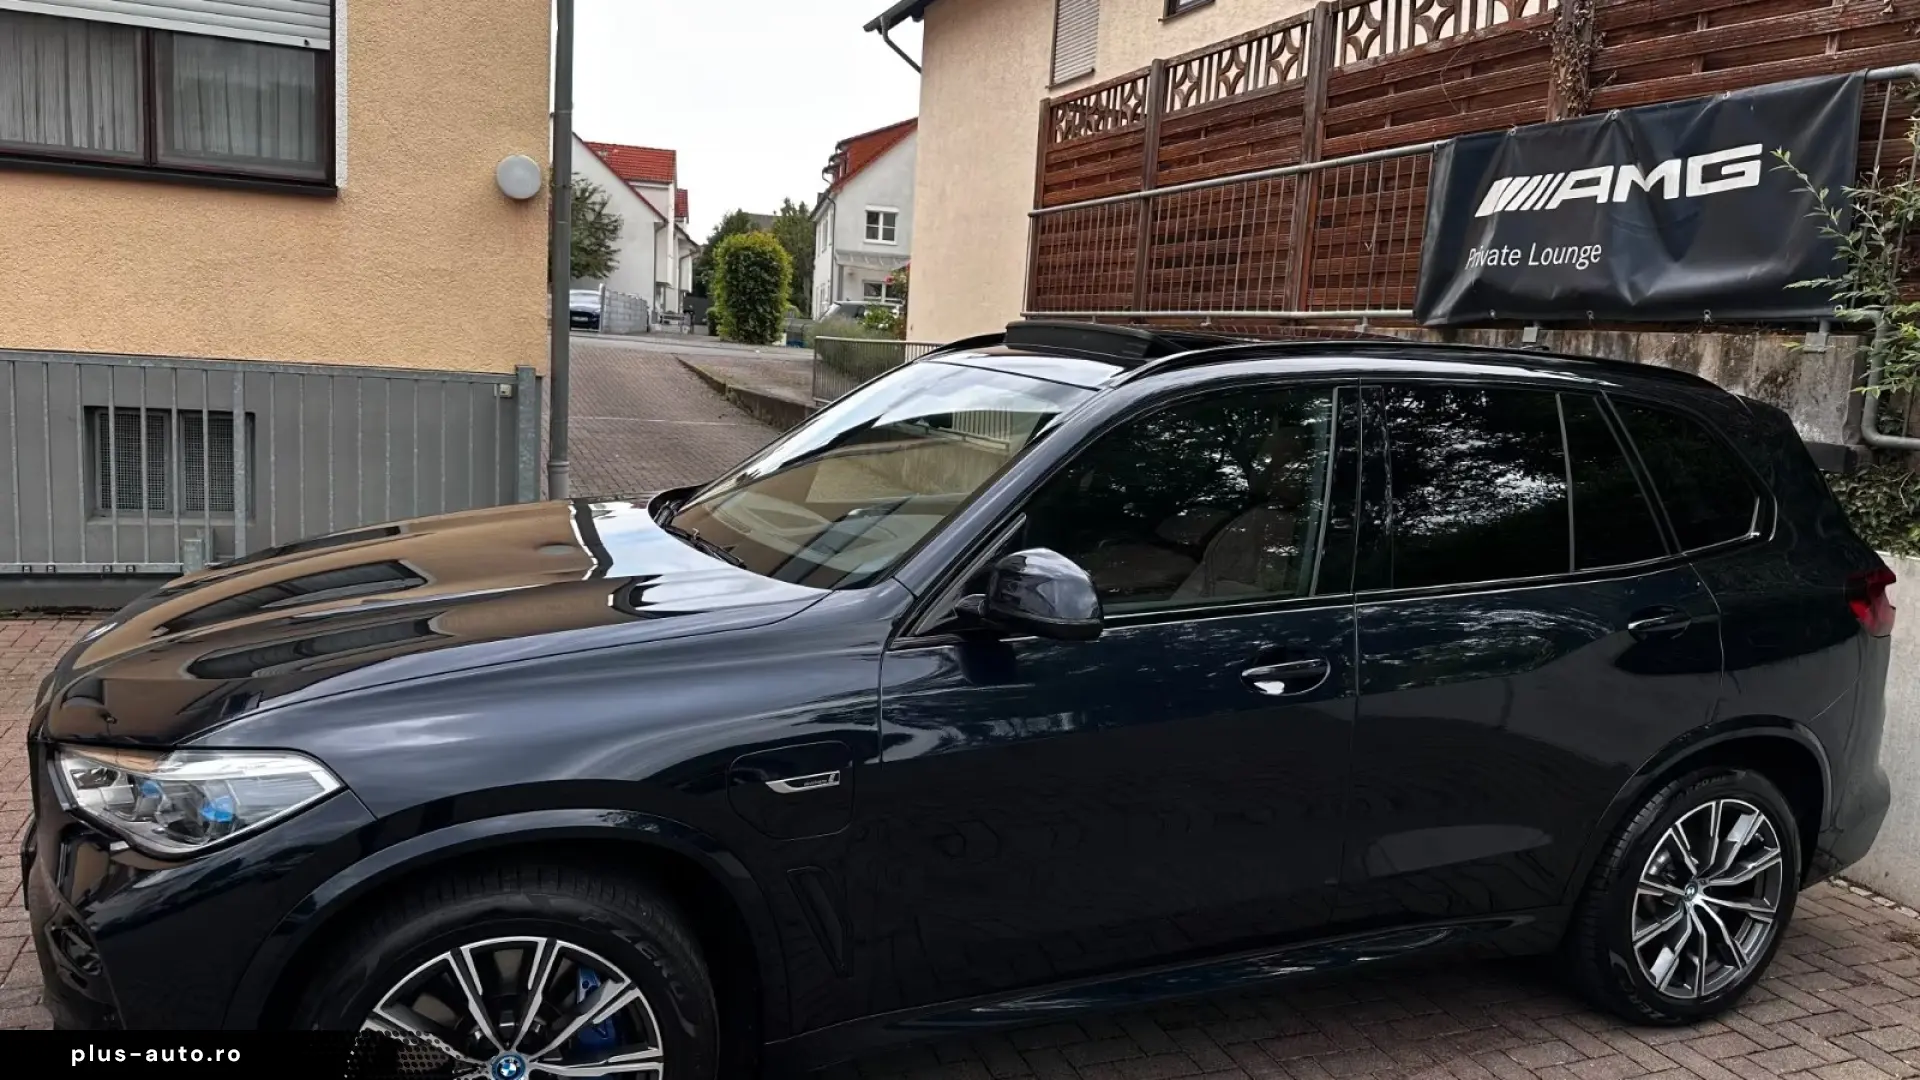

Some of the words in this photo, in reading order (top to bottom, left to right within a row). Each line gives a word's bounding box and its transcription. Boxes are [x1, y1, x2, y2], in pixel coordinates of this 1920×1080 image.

[1546, 143, 1763, 211] AMG
[1464, 244, 1522, 270] Private
[1528, 242, 1602, 270] Lounge
